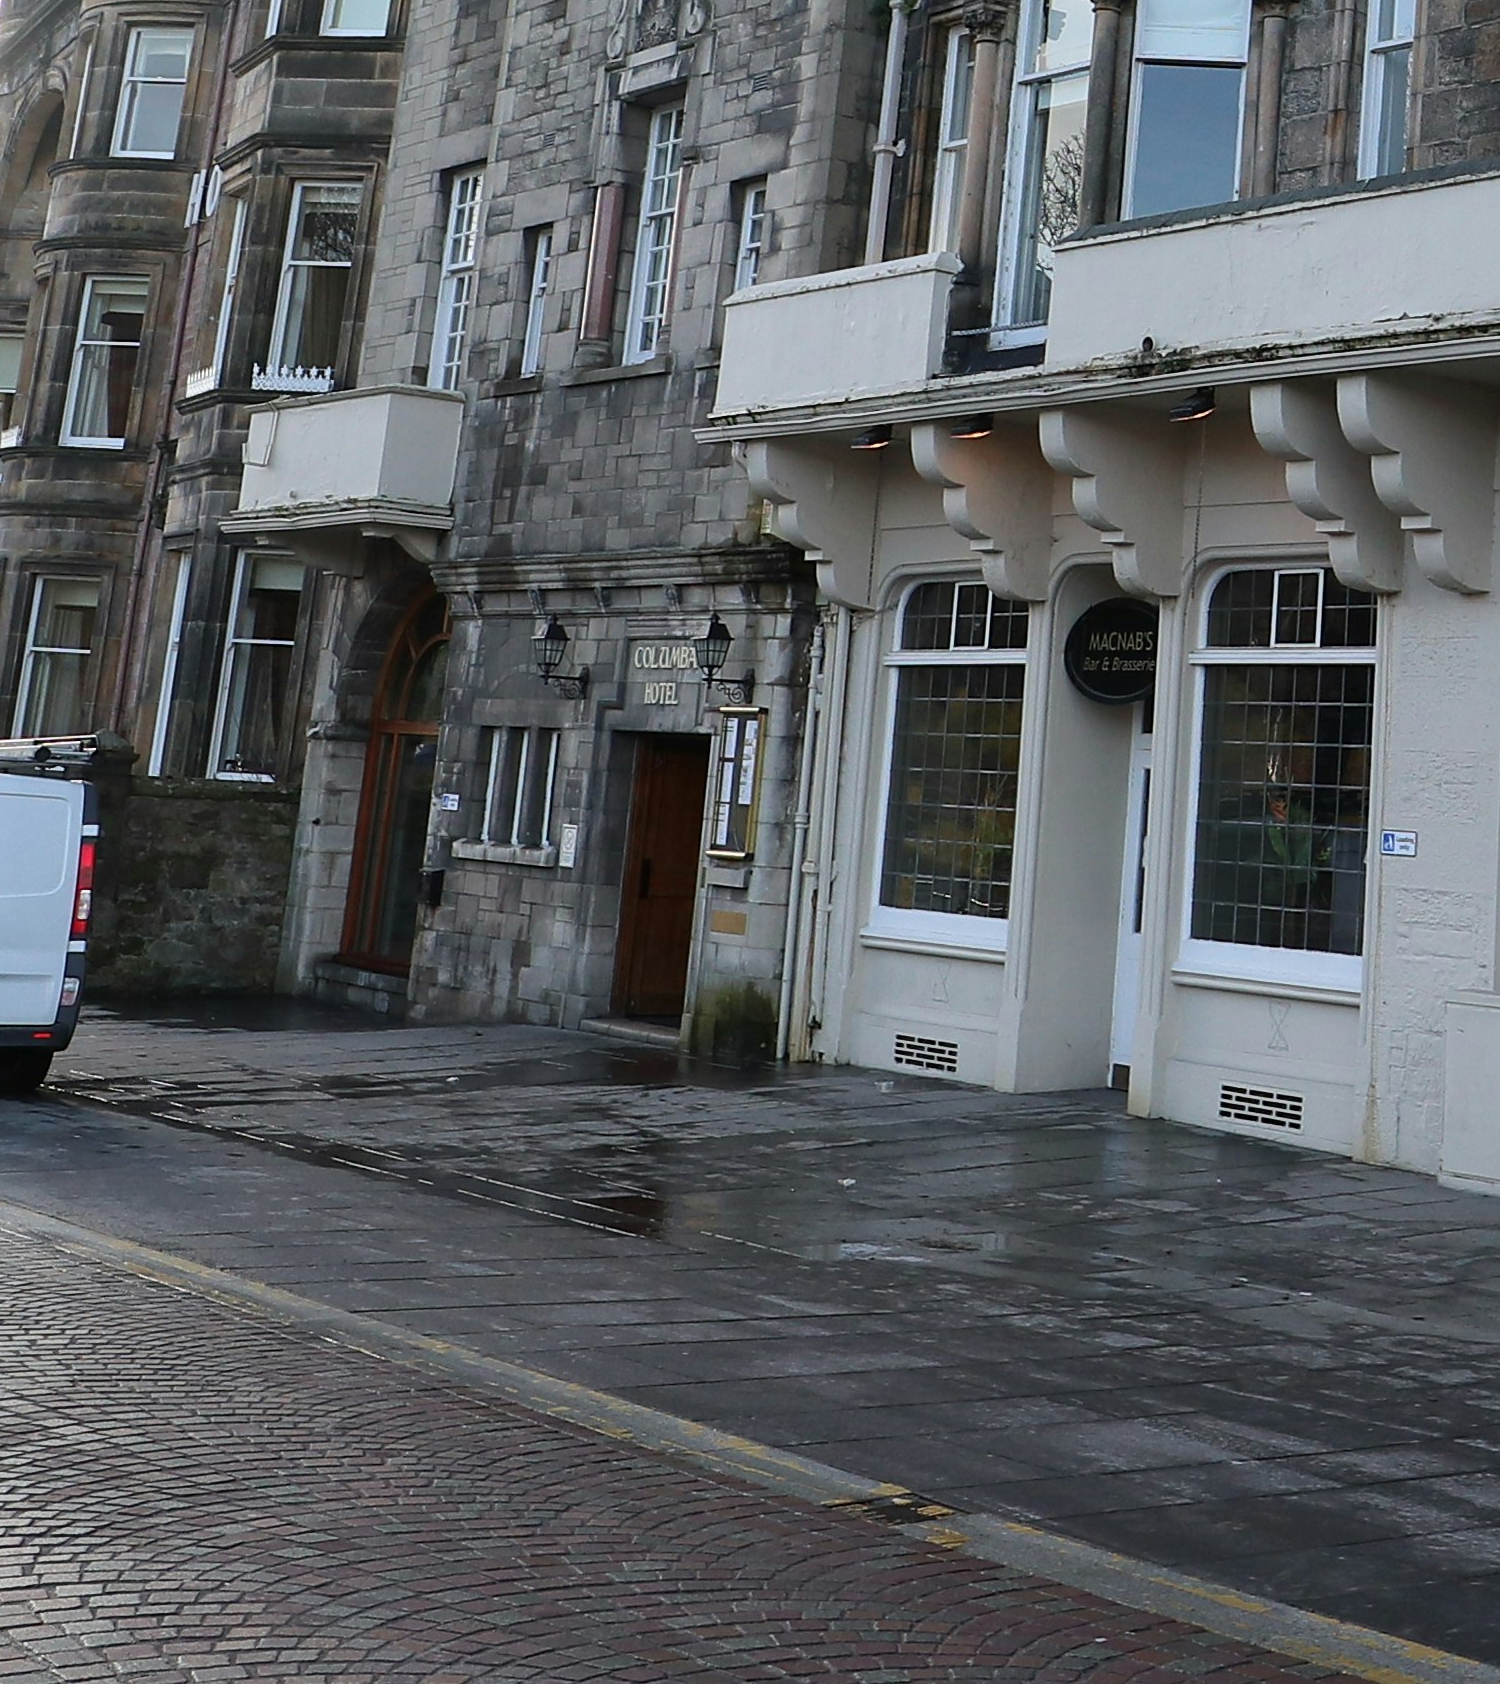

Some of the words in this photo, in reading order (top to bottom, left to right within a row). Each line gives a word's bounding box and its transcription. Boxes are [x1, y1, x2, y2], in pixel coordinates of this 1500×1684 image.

[1088, 631, 1154, 651] MACNAB'S
[634, 646, 699, 669] COLUMBA
[1083, 656, 1100, 671] Bar
[1101, 656, 1110, 671] &
[1111, 656, 1156, 671] Brasserie
[644, 682, 679, 705] HOTEL
